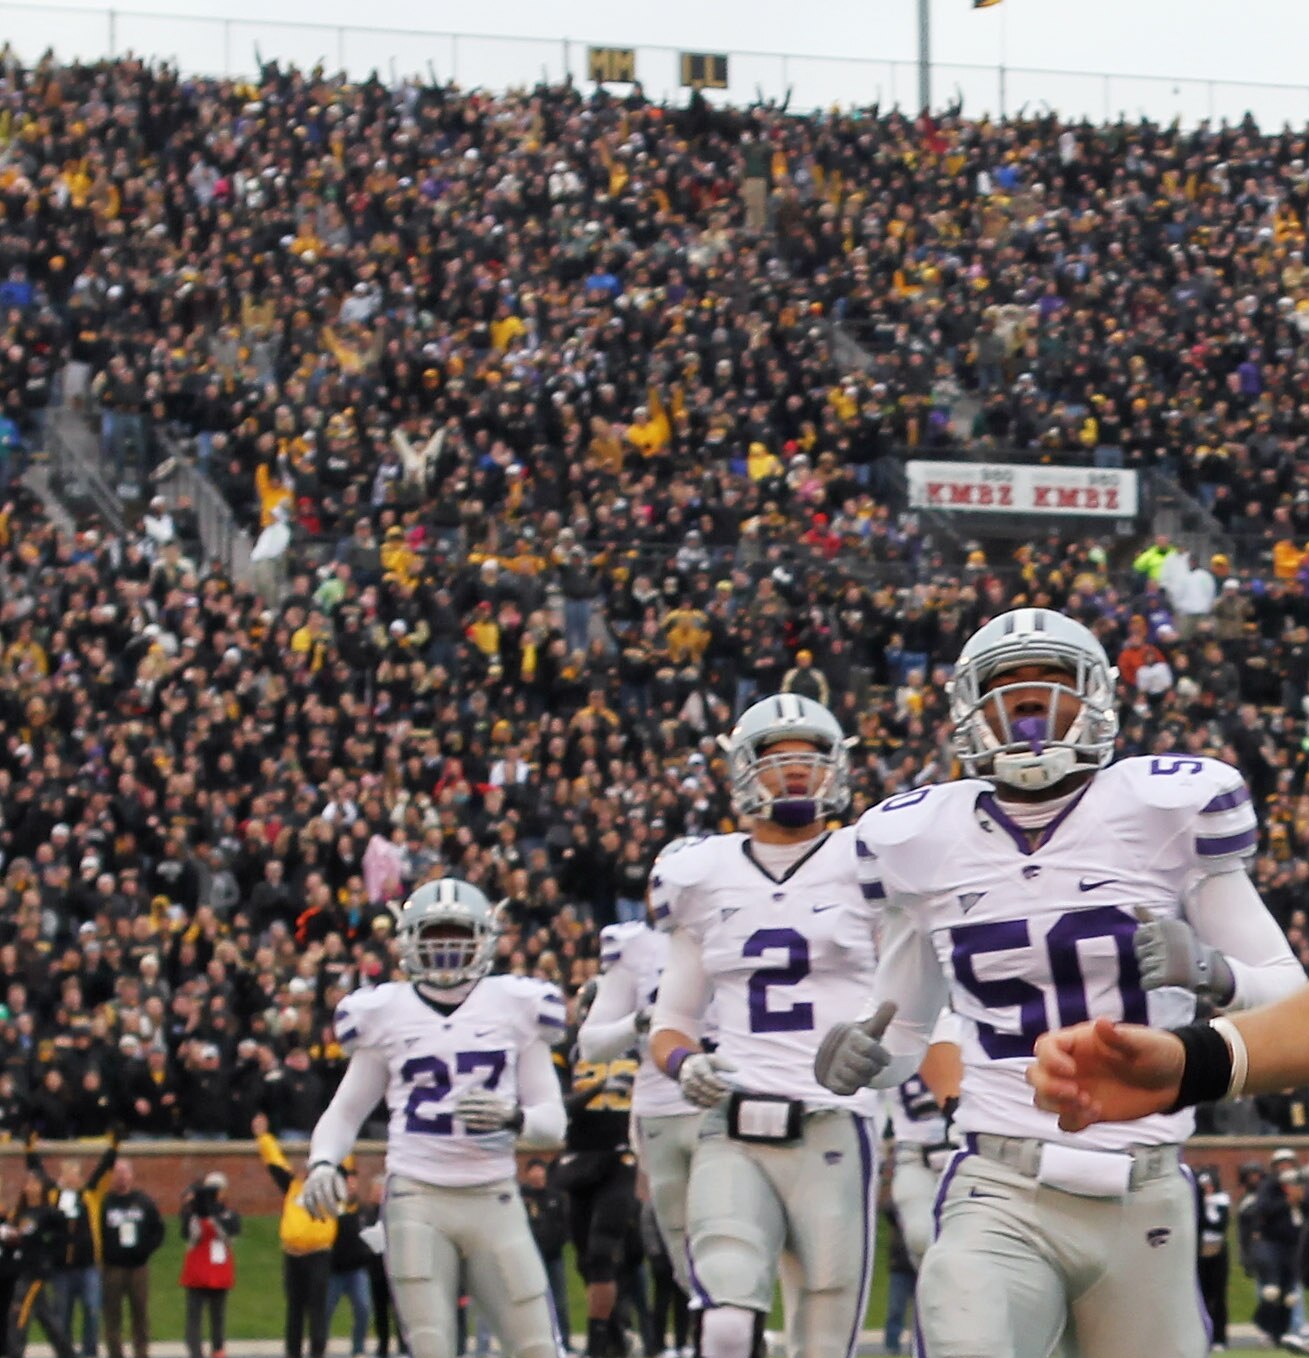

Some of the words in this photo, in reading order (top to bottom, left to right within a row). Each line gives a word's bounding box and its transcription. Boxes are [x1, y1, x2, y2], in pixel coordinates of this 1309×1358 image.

[926, 482, 1013, 506] KMBZ
[1033, 486, 1119, 510] KMBZ
[742, 928, 814, 1034] 2
[950, 905, 1150, 1061] 50
[402, 1049, 507, 1135] 27
